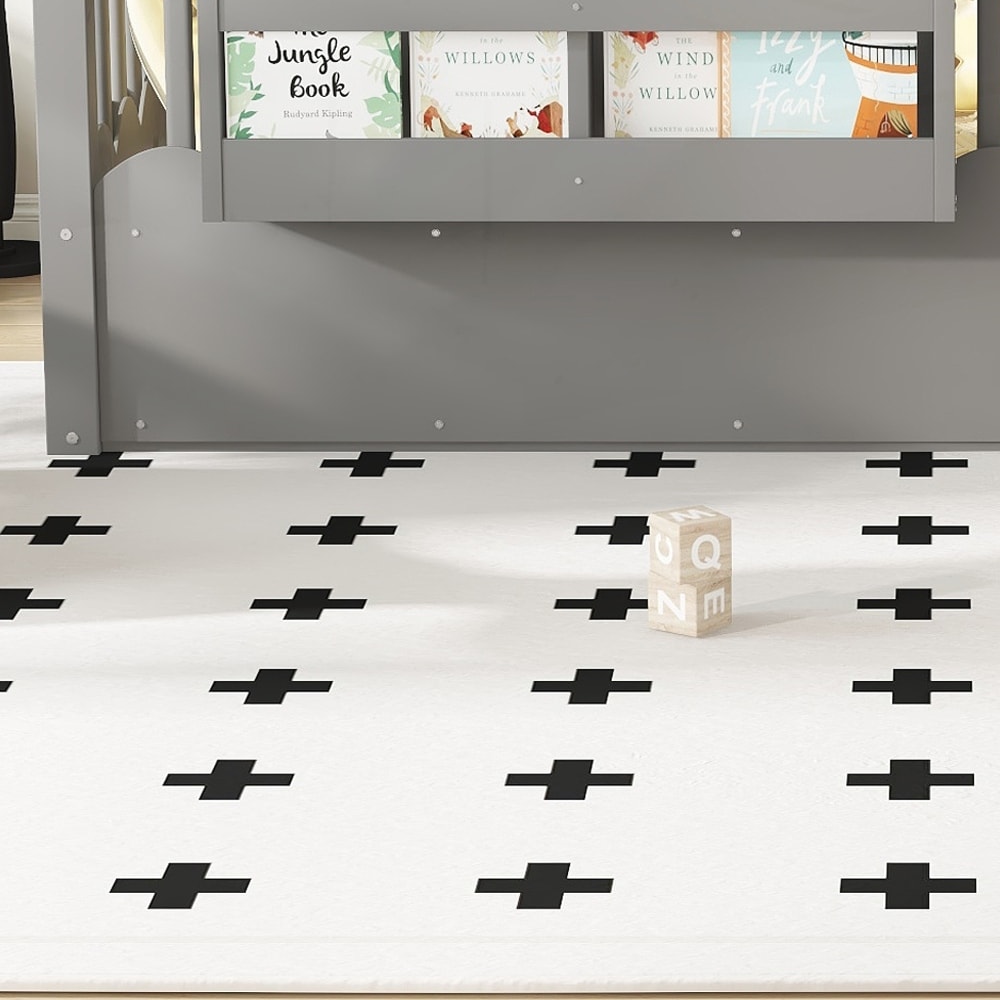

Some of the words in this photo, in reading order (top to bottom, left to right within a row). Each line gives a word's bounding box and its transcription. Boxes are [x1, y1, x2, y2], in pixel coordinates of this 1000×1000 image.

[675, 37, 693, 45] THE
[268, 37, 352, 74] Jungle
[445, 52, 535, 64] WILLOWS
[657, 51, 714, 66] WIND
[769, 58, 794, 75] and
[283, 110, 320, 119] Rudyard
[321, 109, 353, 119] Kipling
[691, 534, 722, 570] Q
[704, 587, 725, 620] E
